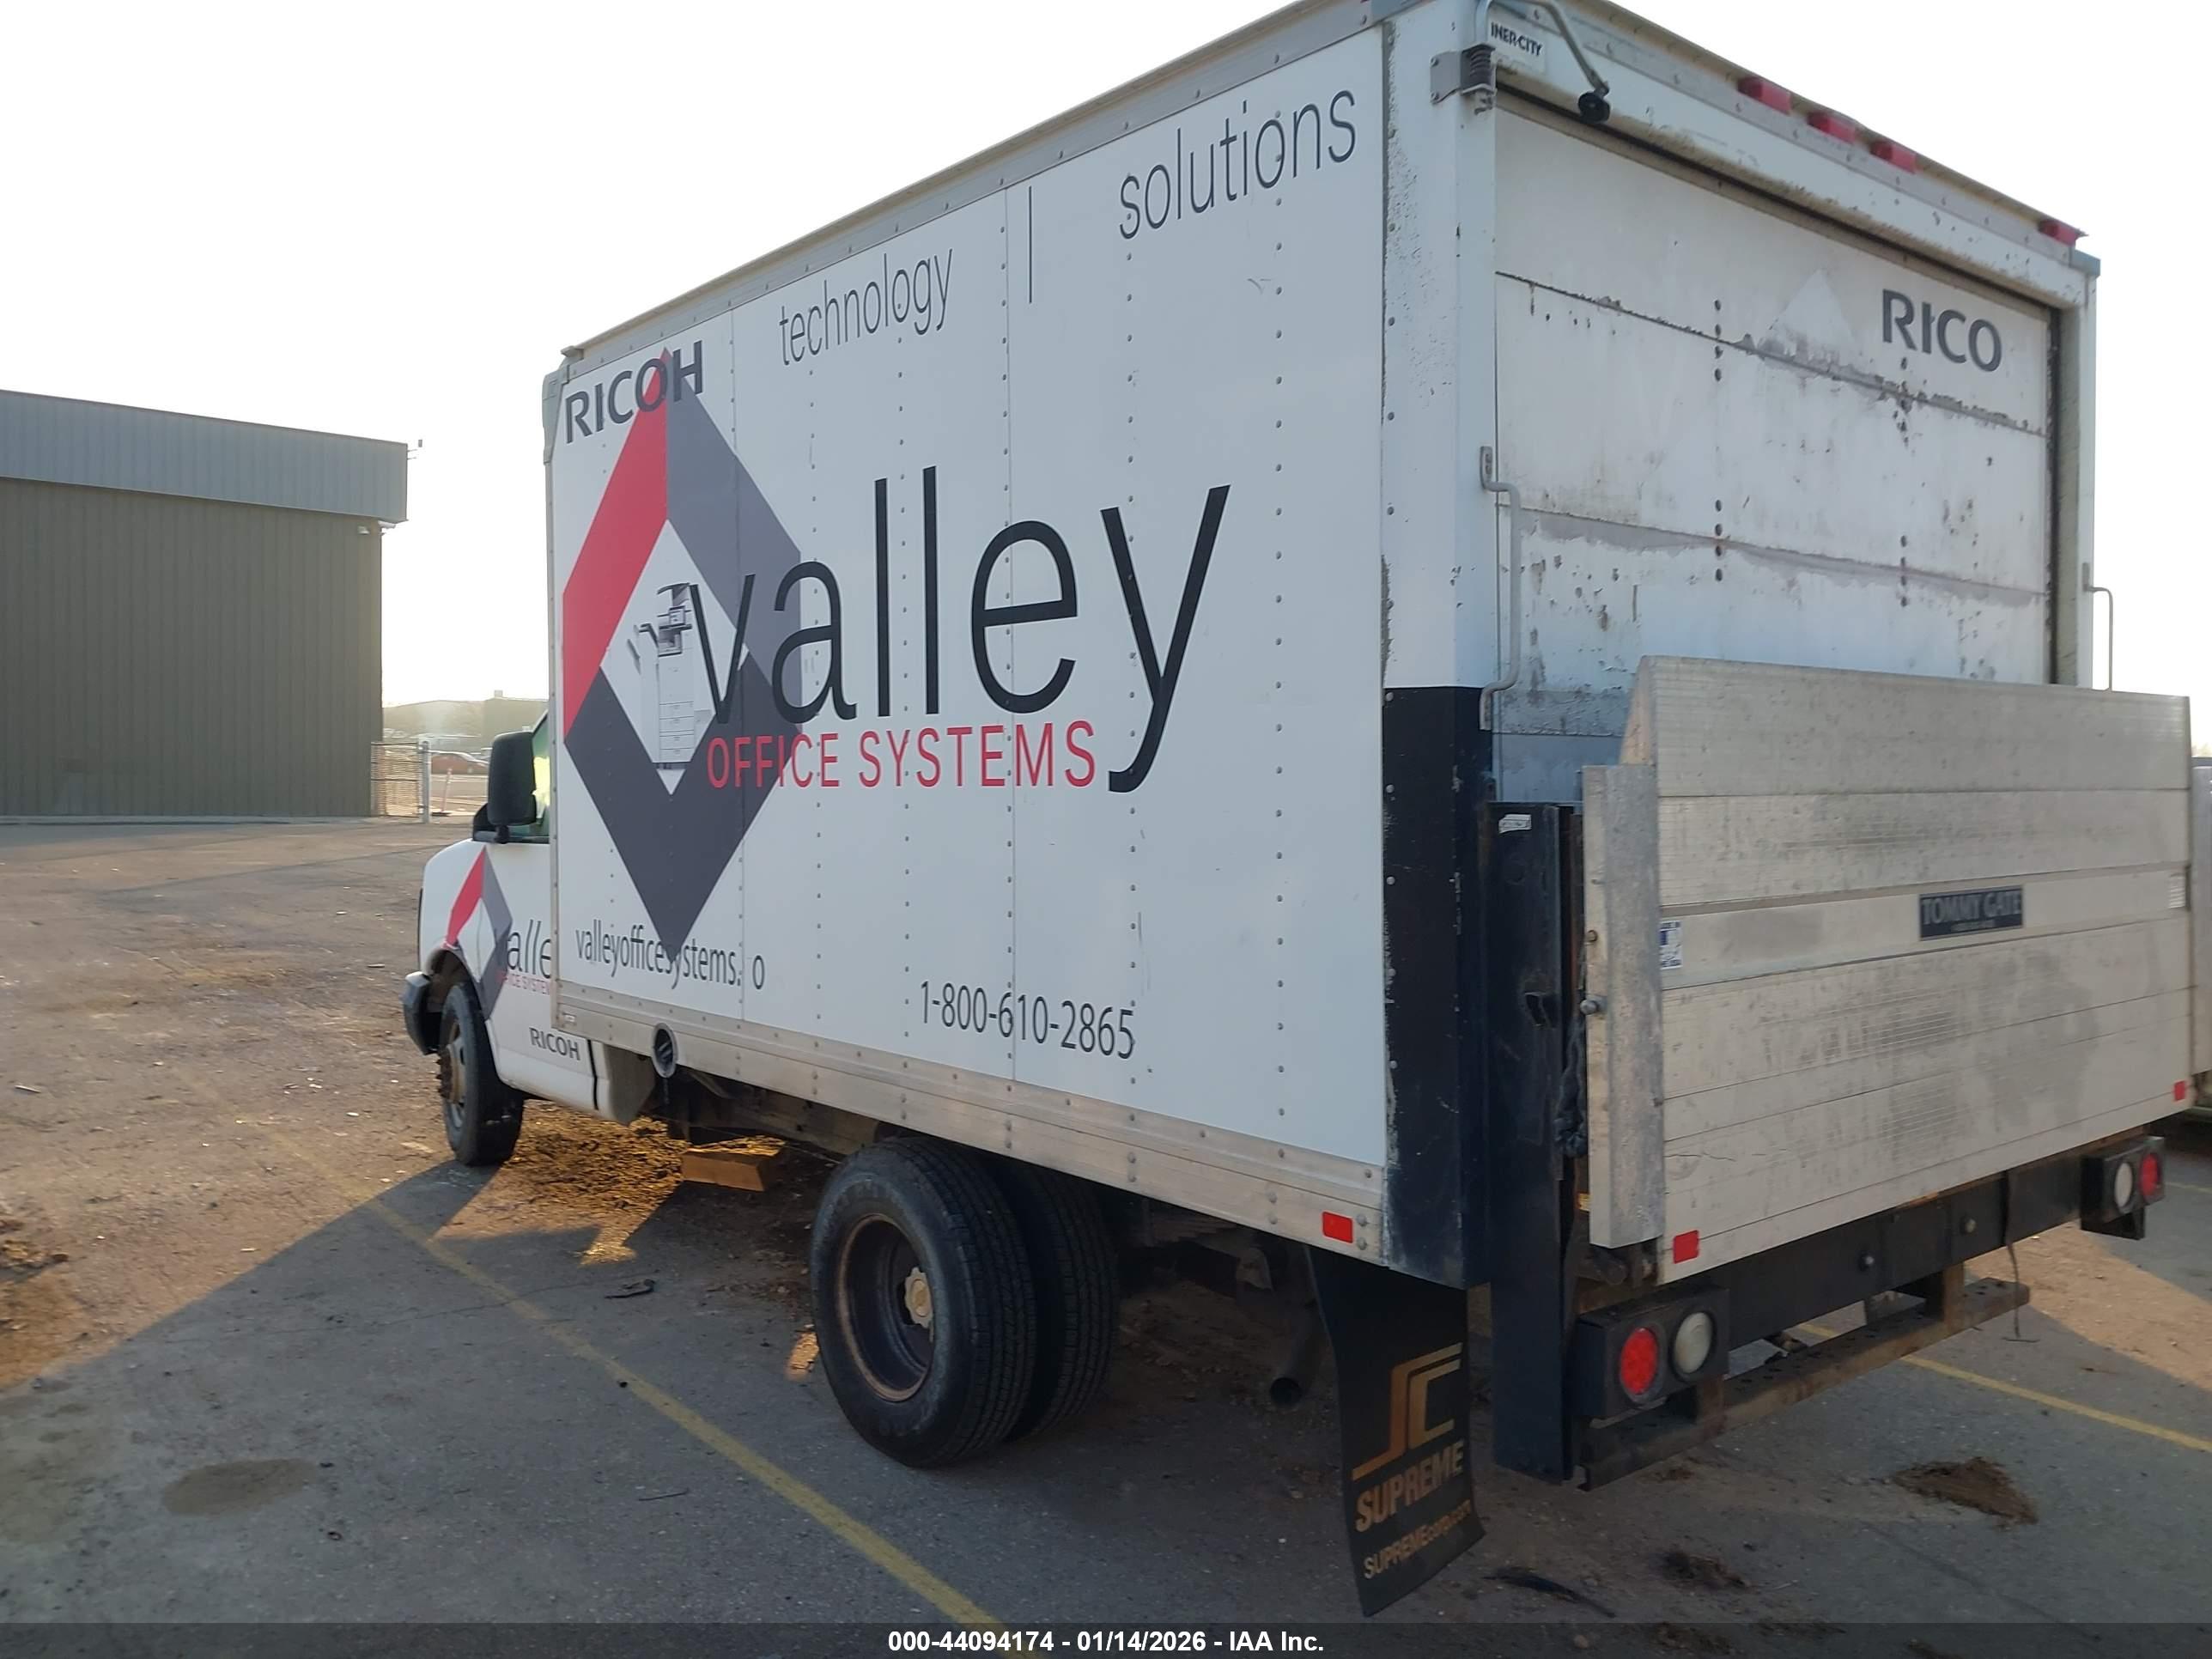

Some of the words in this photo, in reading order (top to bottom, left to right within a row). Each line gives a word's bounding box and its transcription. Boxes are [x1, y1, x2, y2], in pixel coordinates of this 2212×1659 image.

[779, 248, 953, 366] technology
[1119, 89, 1356, 240] solutions
[1882, 289, 2002, 372] RICO
[564, 340, 703, 444] RICOH
[688, 465, 1231, 793] valley
[706, 732, 840, 789] OFFICE
[858, 720, 1097, 788] SYSTEMS
[529, 1027, 580, 1061] RICOH
[921, 981, 1134, 1059] 1-800-610-2865
[1355, 1439, 1464, 1532] SUPREME
